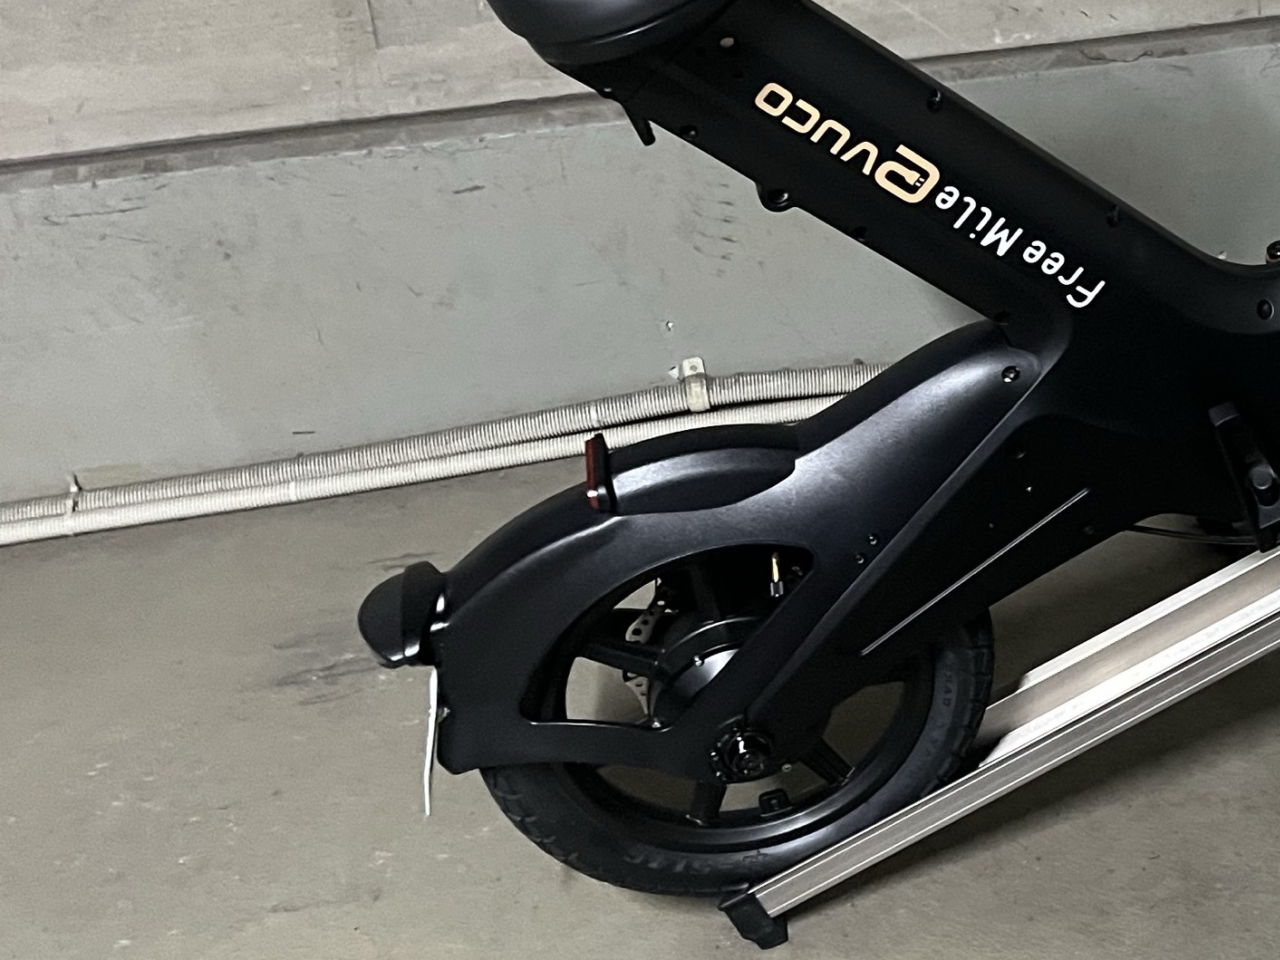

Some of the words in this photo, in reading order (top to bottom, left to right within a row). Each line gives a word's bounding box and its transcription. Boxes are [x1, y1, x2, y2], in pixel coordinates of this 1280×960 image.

[754, 82, 941, 204] evuco
[934, 185, 1024, 257] Mile
[1022, 240, 1106, 309] Free
